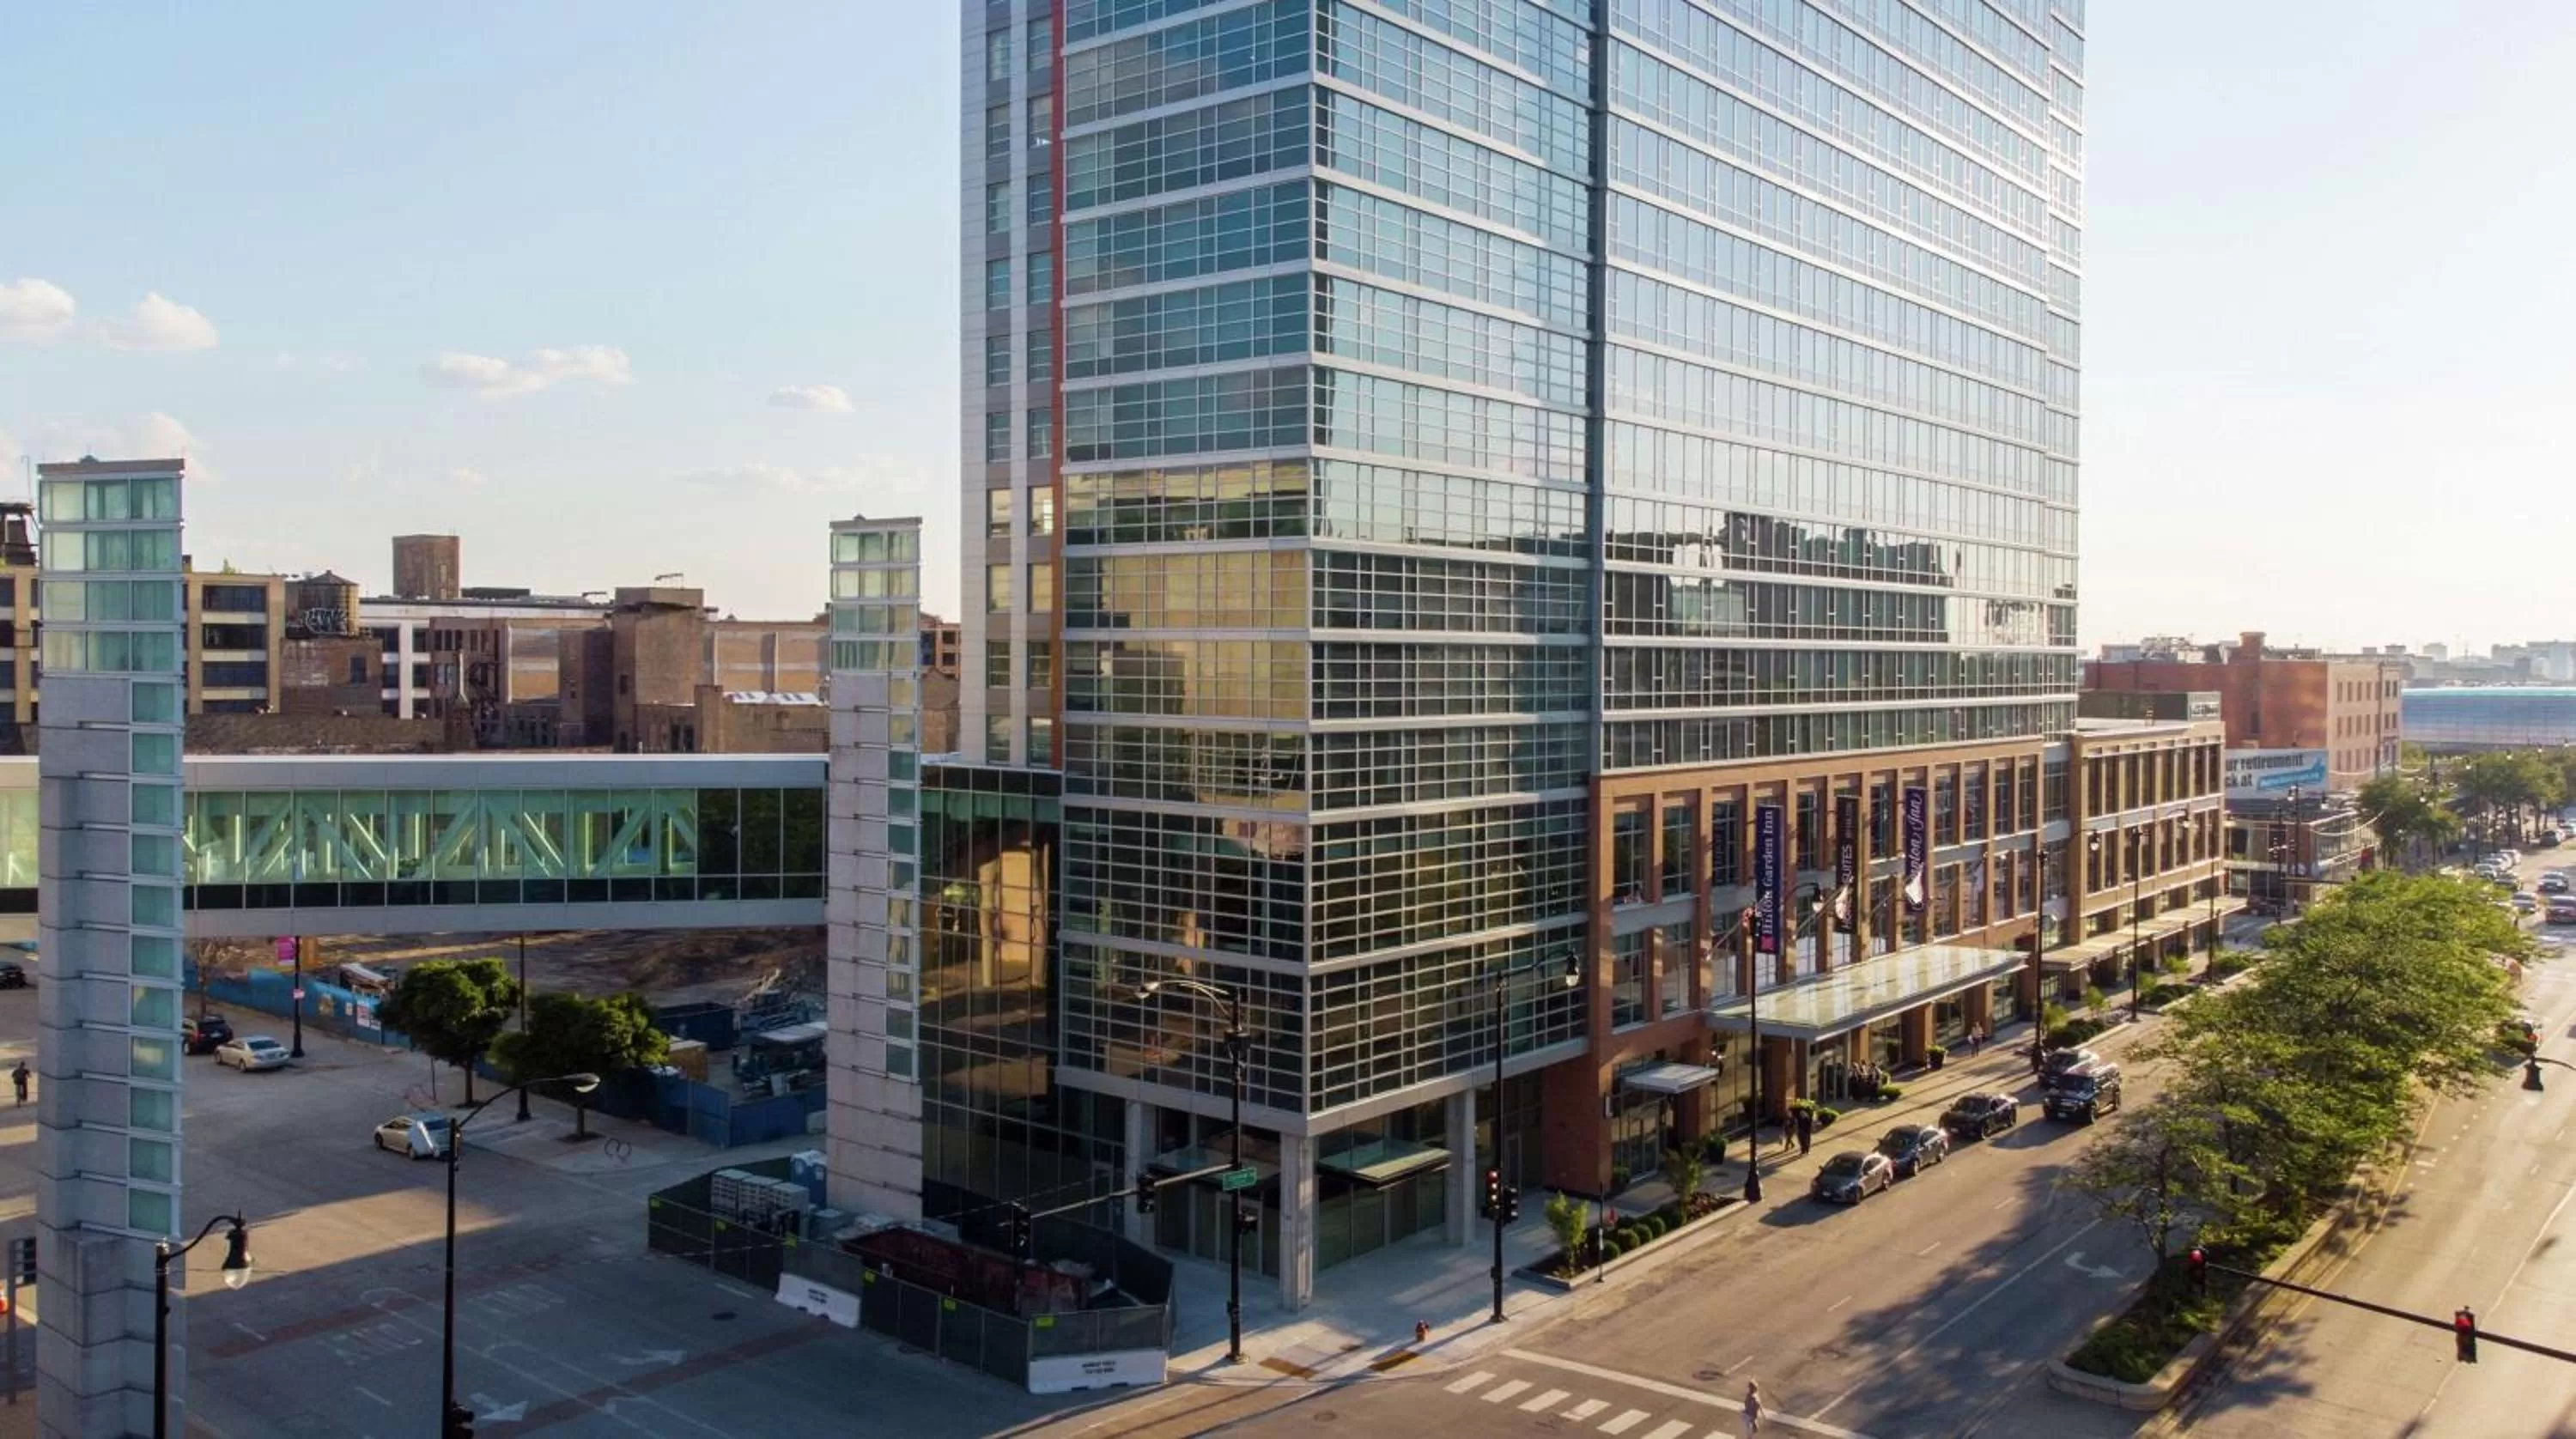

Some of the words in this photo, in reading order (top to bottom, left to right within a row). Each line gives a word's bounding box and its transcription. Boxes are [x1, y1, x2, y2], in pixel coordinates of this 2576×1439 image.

[2240, 754, 2303, 769] retirement
[1762, 811, 1773, 835] Inn
[1762, 839, 1773, 887] Garden
[1762, 890, 1773, 935] Hilton
